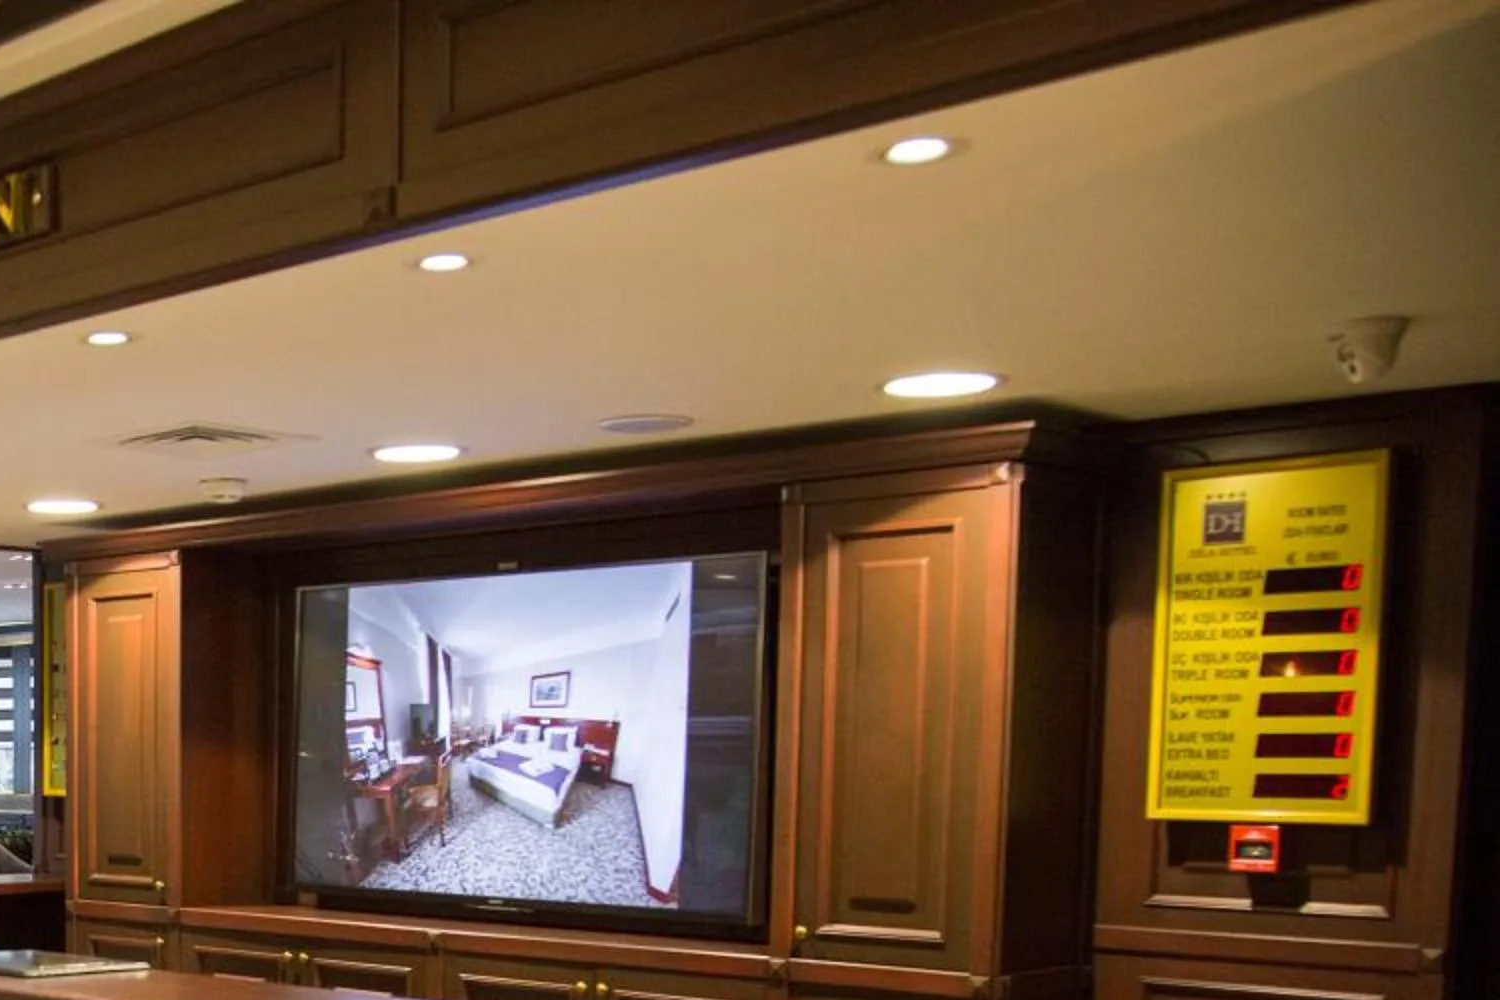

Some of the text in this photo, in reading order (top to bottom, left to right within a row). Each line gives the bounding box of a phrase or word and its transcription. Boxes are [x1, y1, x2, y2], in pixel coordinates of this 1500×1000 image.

[1173, 627, 1255, 641] DOUBLE ROOM
[1171, 668, 1249, 680] TRIPLE ROOM
[1167, 748, 1202, 760] EXTRA
[1165, 786, 1231, 798] BREAKFAST
